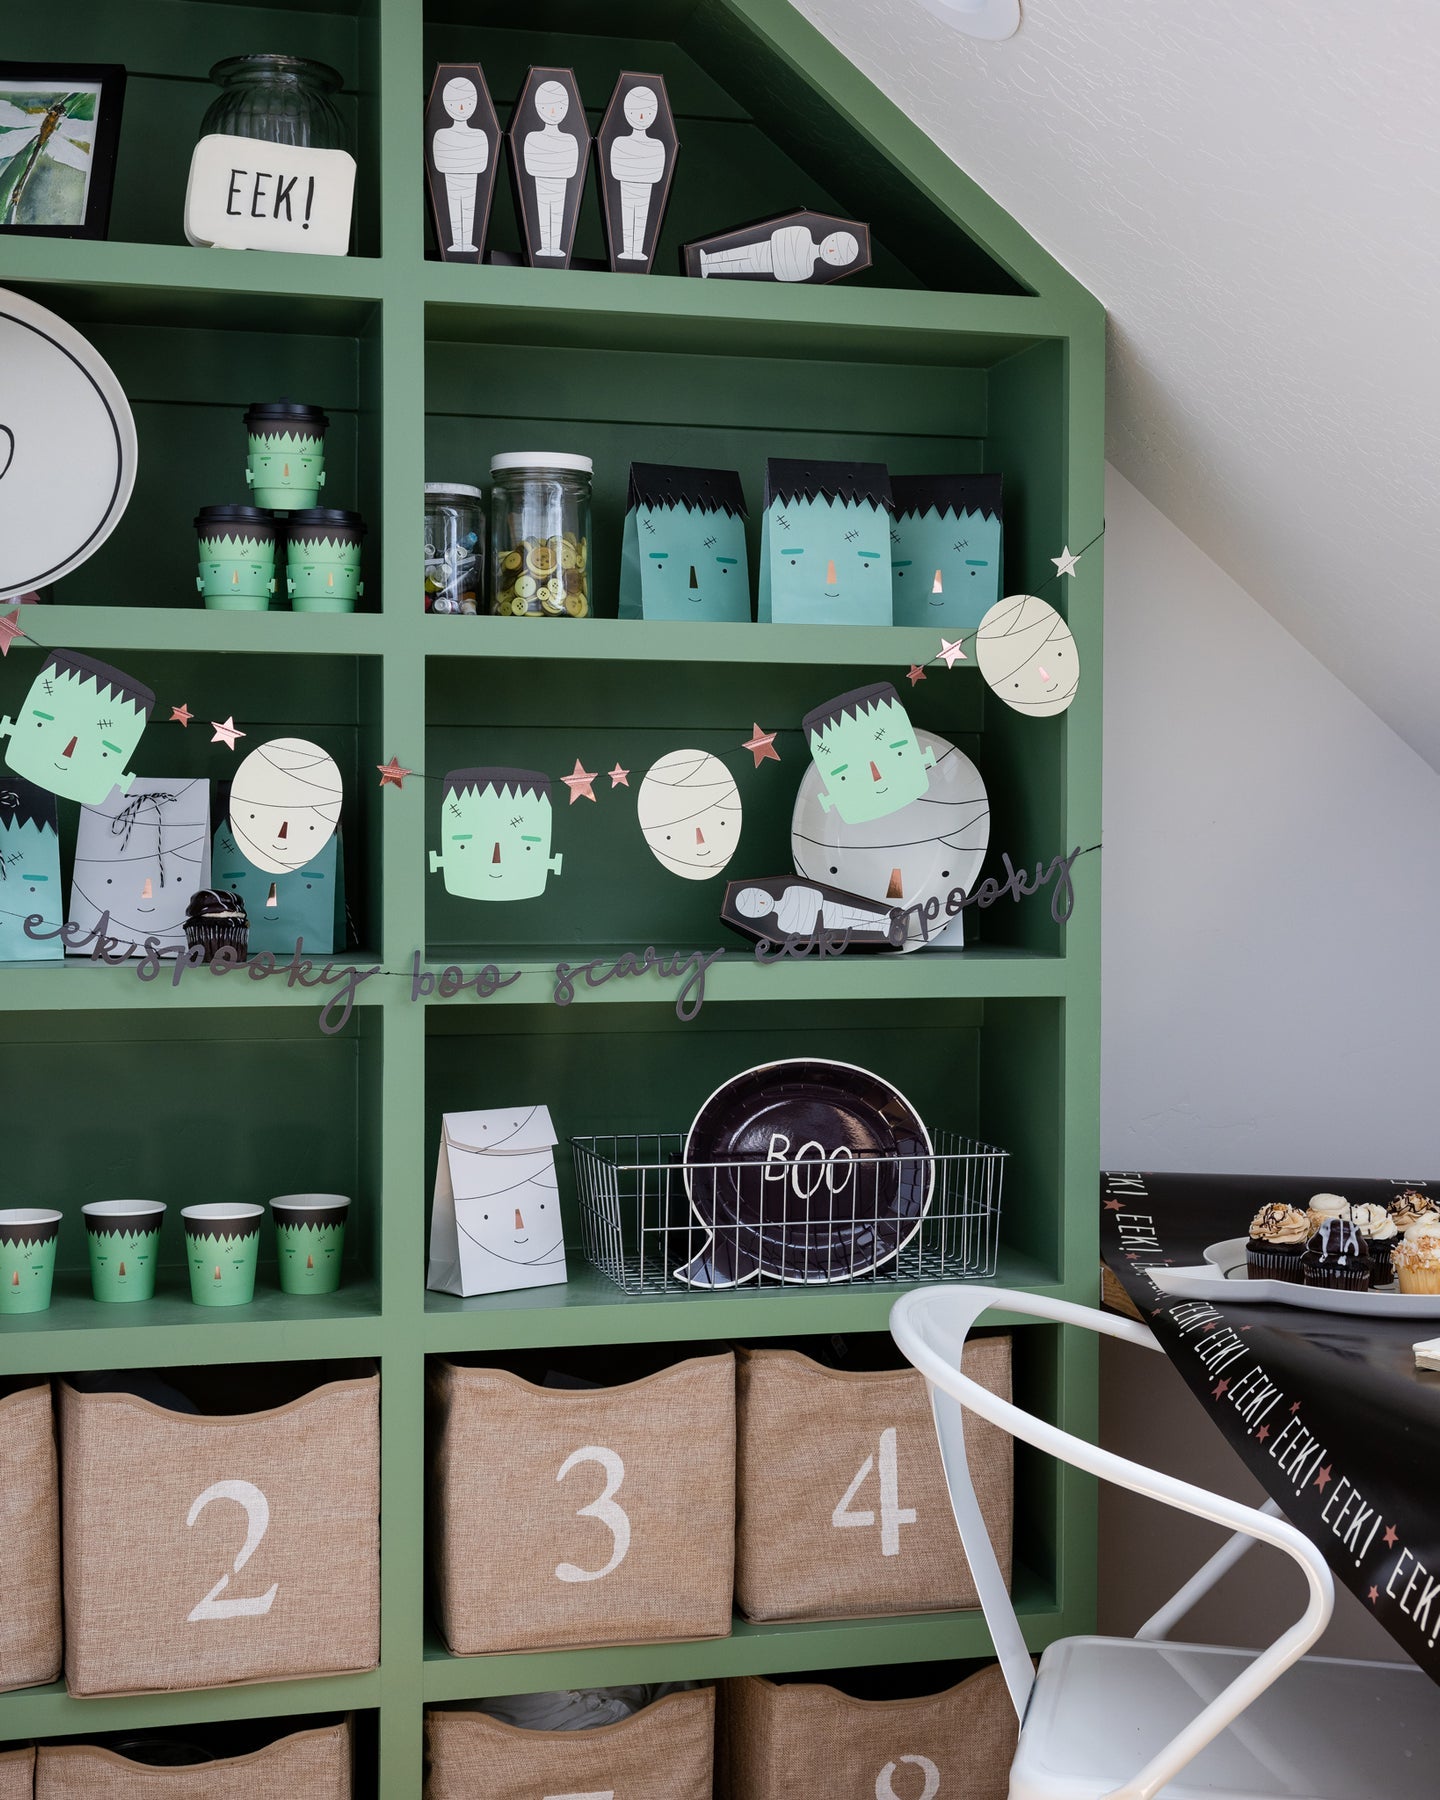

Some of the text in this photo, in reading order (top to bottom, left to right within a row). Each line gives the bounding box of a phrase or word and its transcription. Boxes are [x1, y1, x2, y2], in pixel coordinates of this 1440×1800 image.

[226, 168, 314, 230] EEK!
[23, 846, 1082, 1035] eek spooky boo scary eek spooky
[764, 1133, 853, 1200] BOO
[1105, 1171, 1149, 1196] EK!
[1115, 1213, 1163, 1253] EEK!
[1169, 1302, 1224, 1338] EEK!
[1194, 1327, 1250, 1382] EEK!
[1227, 1365, 1284, 1435] EEK!
[1269, 1415, 1328, 1497] EEK!
[554, 1445, 632, 1582] 3
[831, 1427, 917, 1556] 4
[1321, 1475, 1382, 1568] EEK!
[186, 1479, 279, 1622] 2
